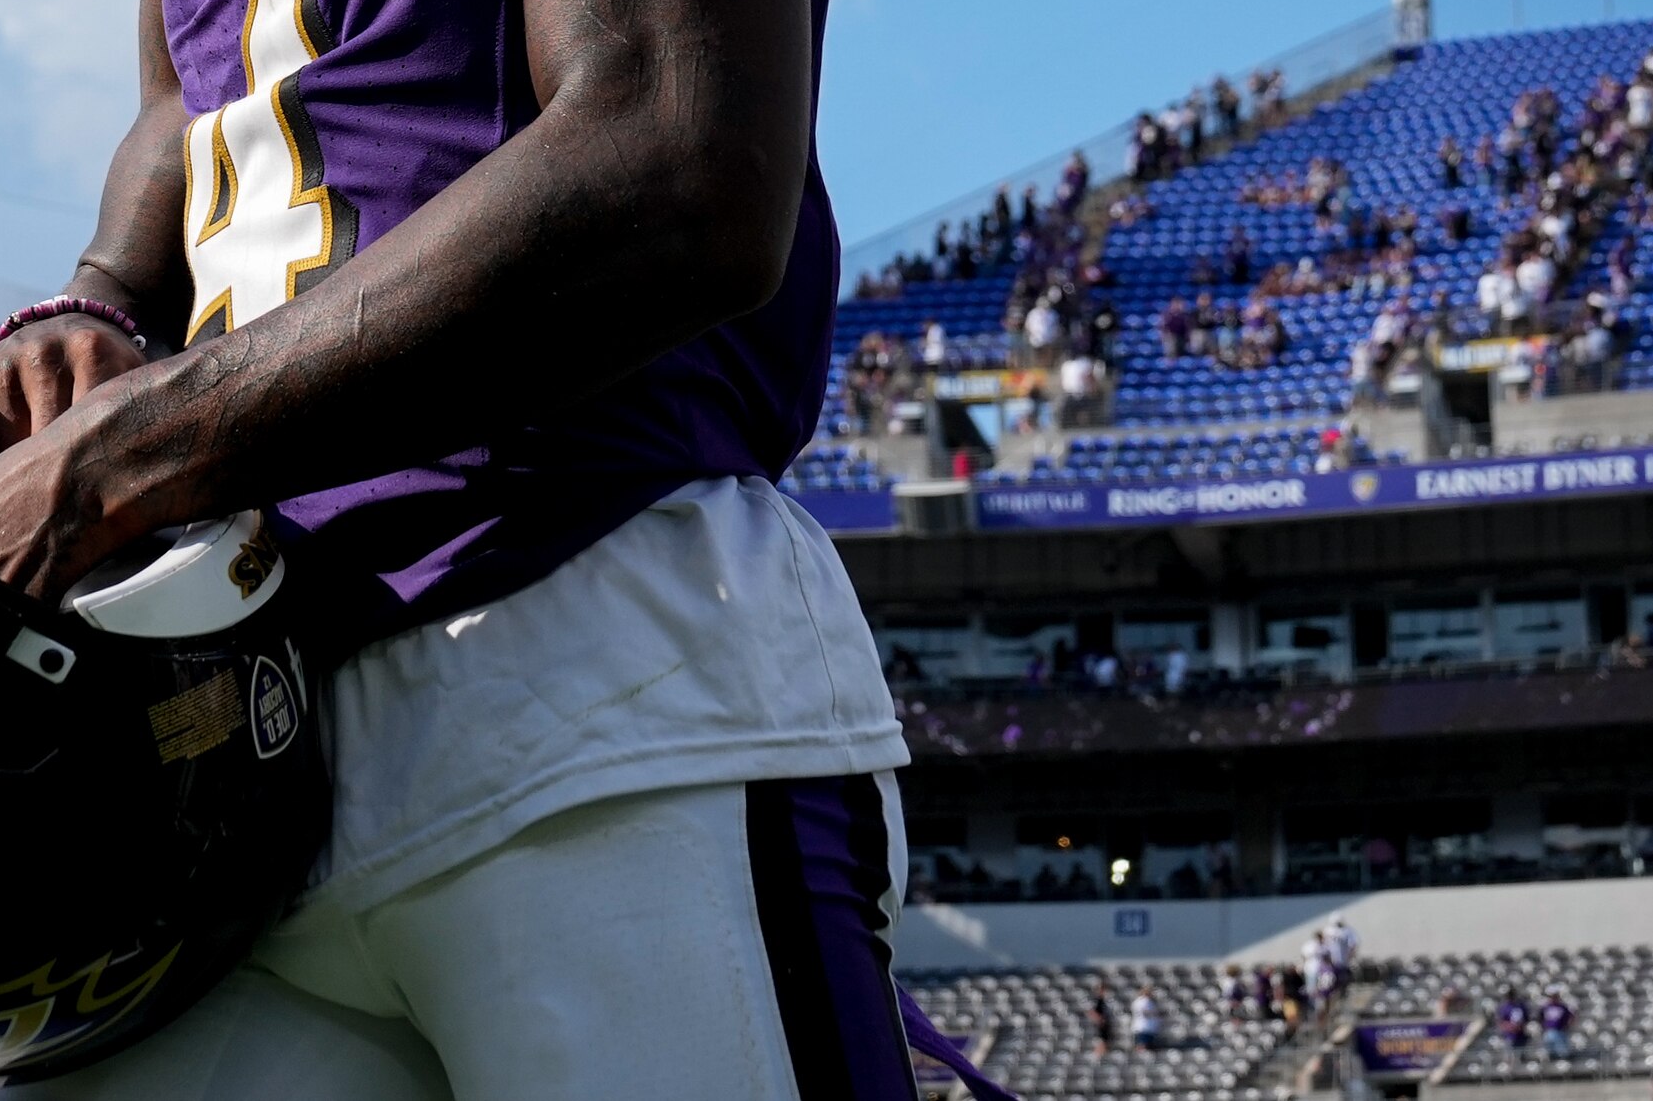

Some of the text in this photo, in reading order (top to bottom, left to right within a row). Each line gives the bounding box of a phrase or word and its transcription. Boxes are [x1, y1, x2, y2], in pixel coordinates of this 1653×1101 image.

[1415, 462, 1539, 500] EARNEST
[1542, 455, 1638, 491] BYNER
[1108, 487, 1182, 517] RING
[1198, 478, 1306, 513] HONOR
[258, 681, 285, 721] JACOBY
[261, 673, 273, 692] 12
[272, 703, 292, 740] JOE
